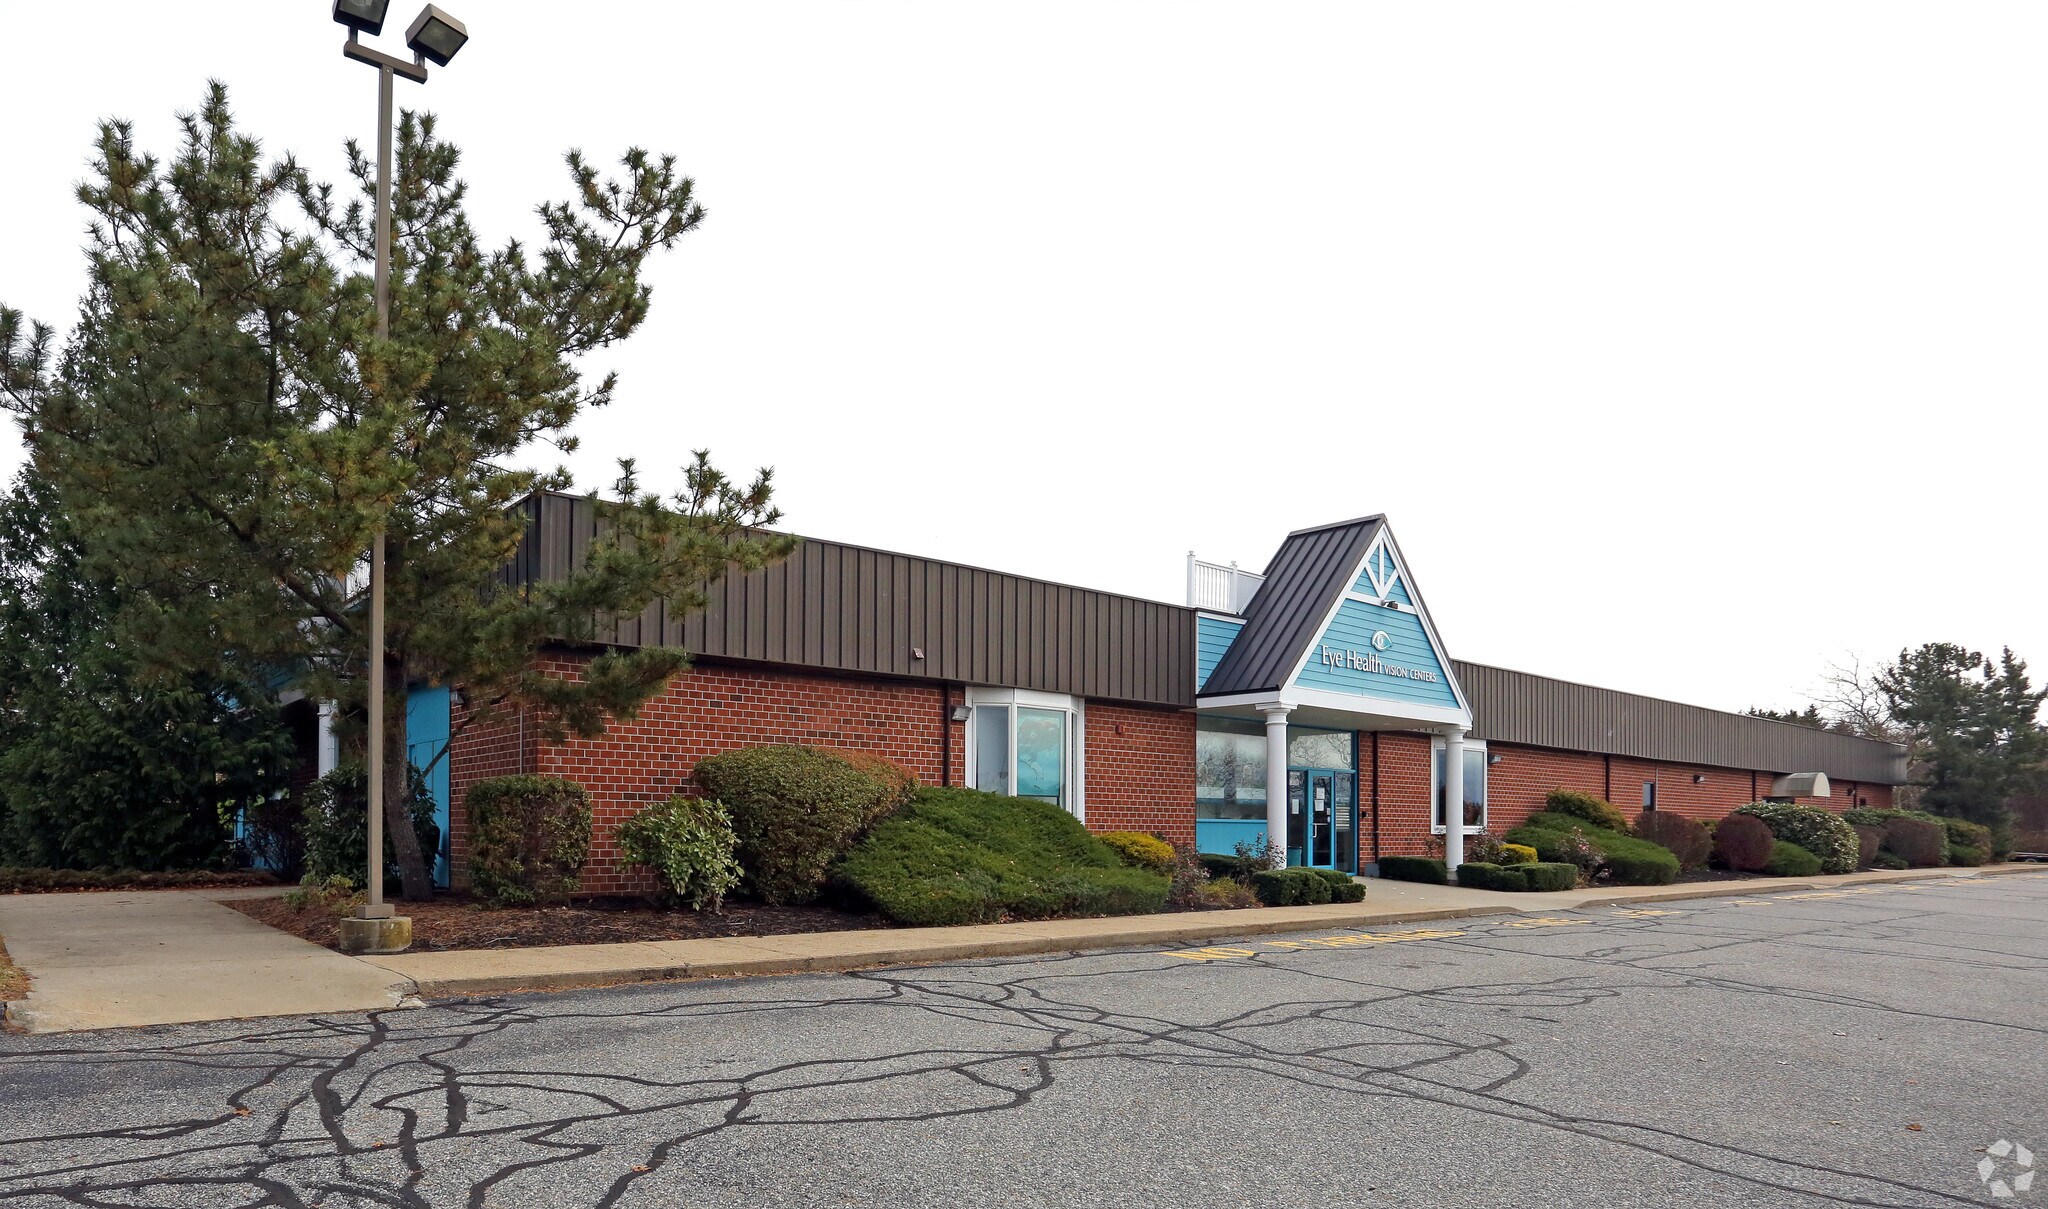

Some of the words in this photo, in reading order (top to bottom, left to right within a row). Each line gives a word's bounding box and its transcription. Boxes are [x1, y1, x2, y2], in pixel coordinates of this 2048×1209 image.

[1322, 645, 1343, 672] Eye
[1346, 649, 1382, 674] Health
[1384, 665, 1408, 678] VISION
[1410, 669, 1437, 683] CENTERS
[1158, 947, 1255, 961] NO
